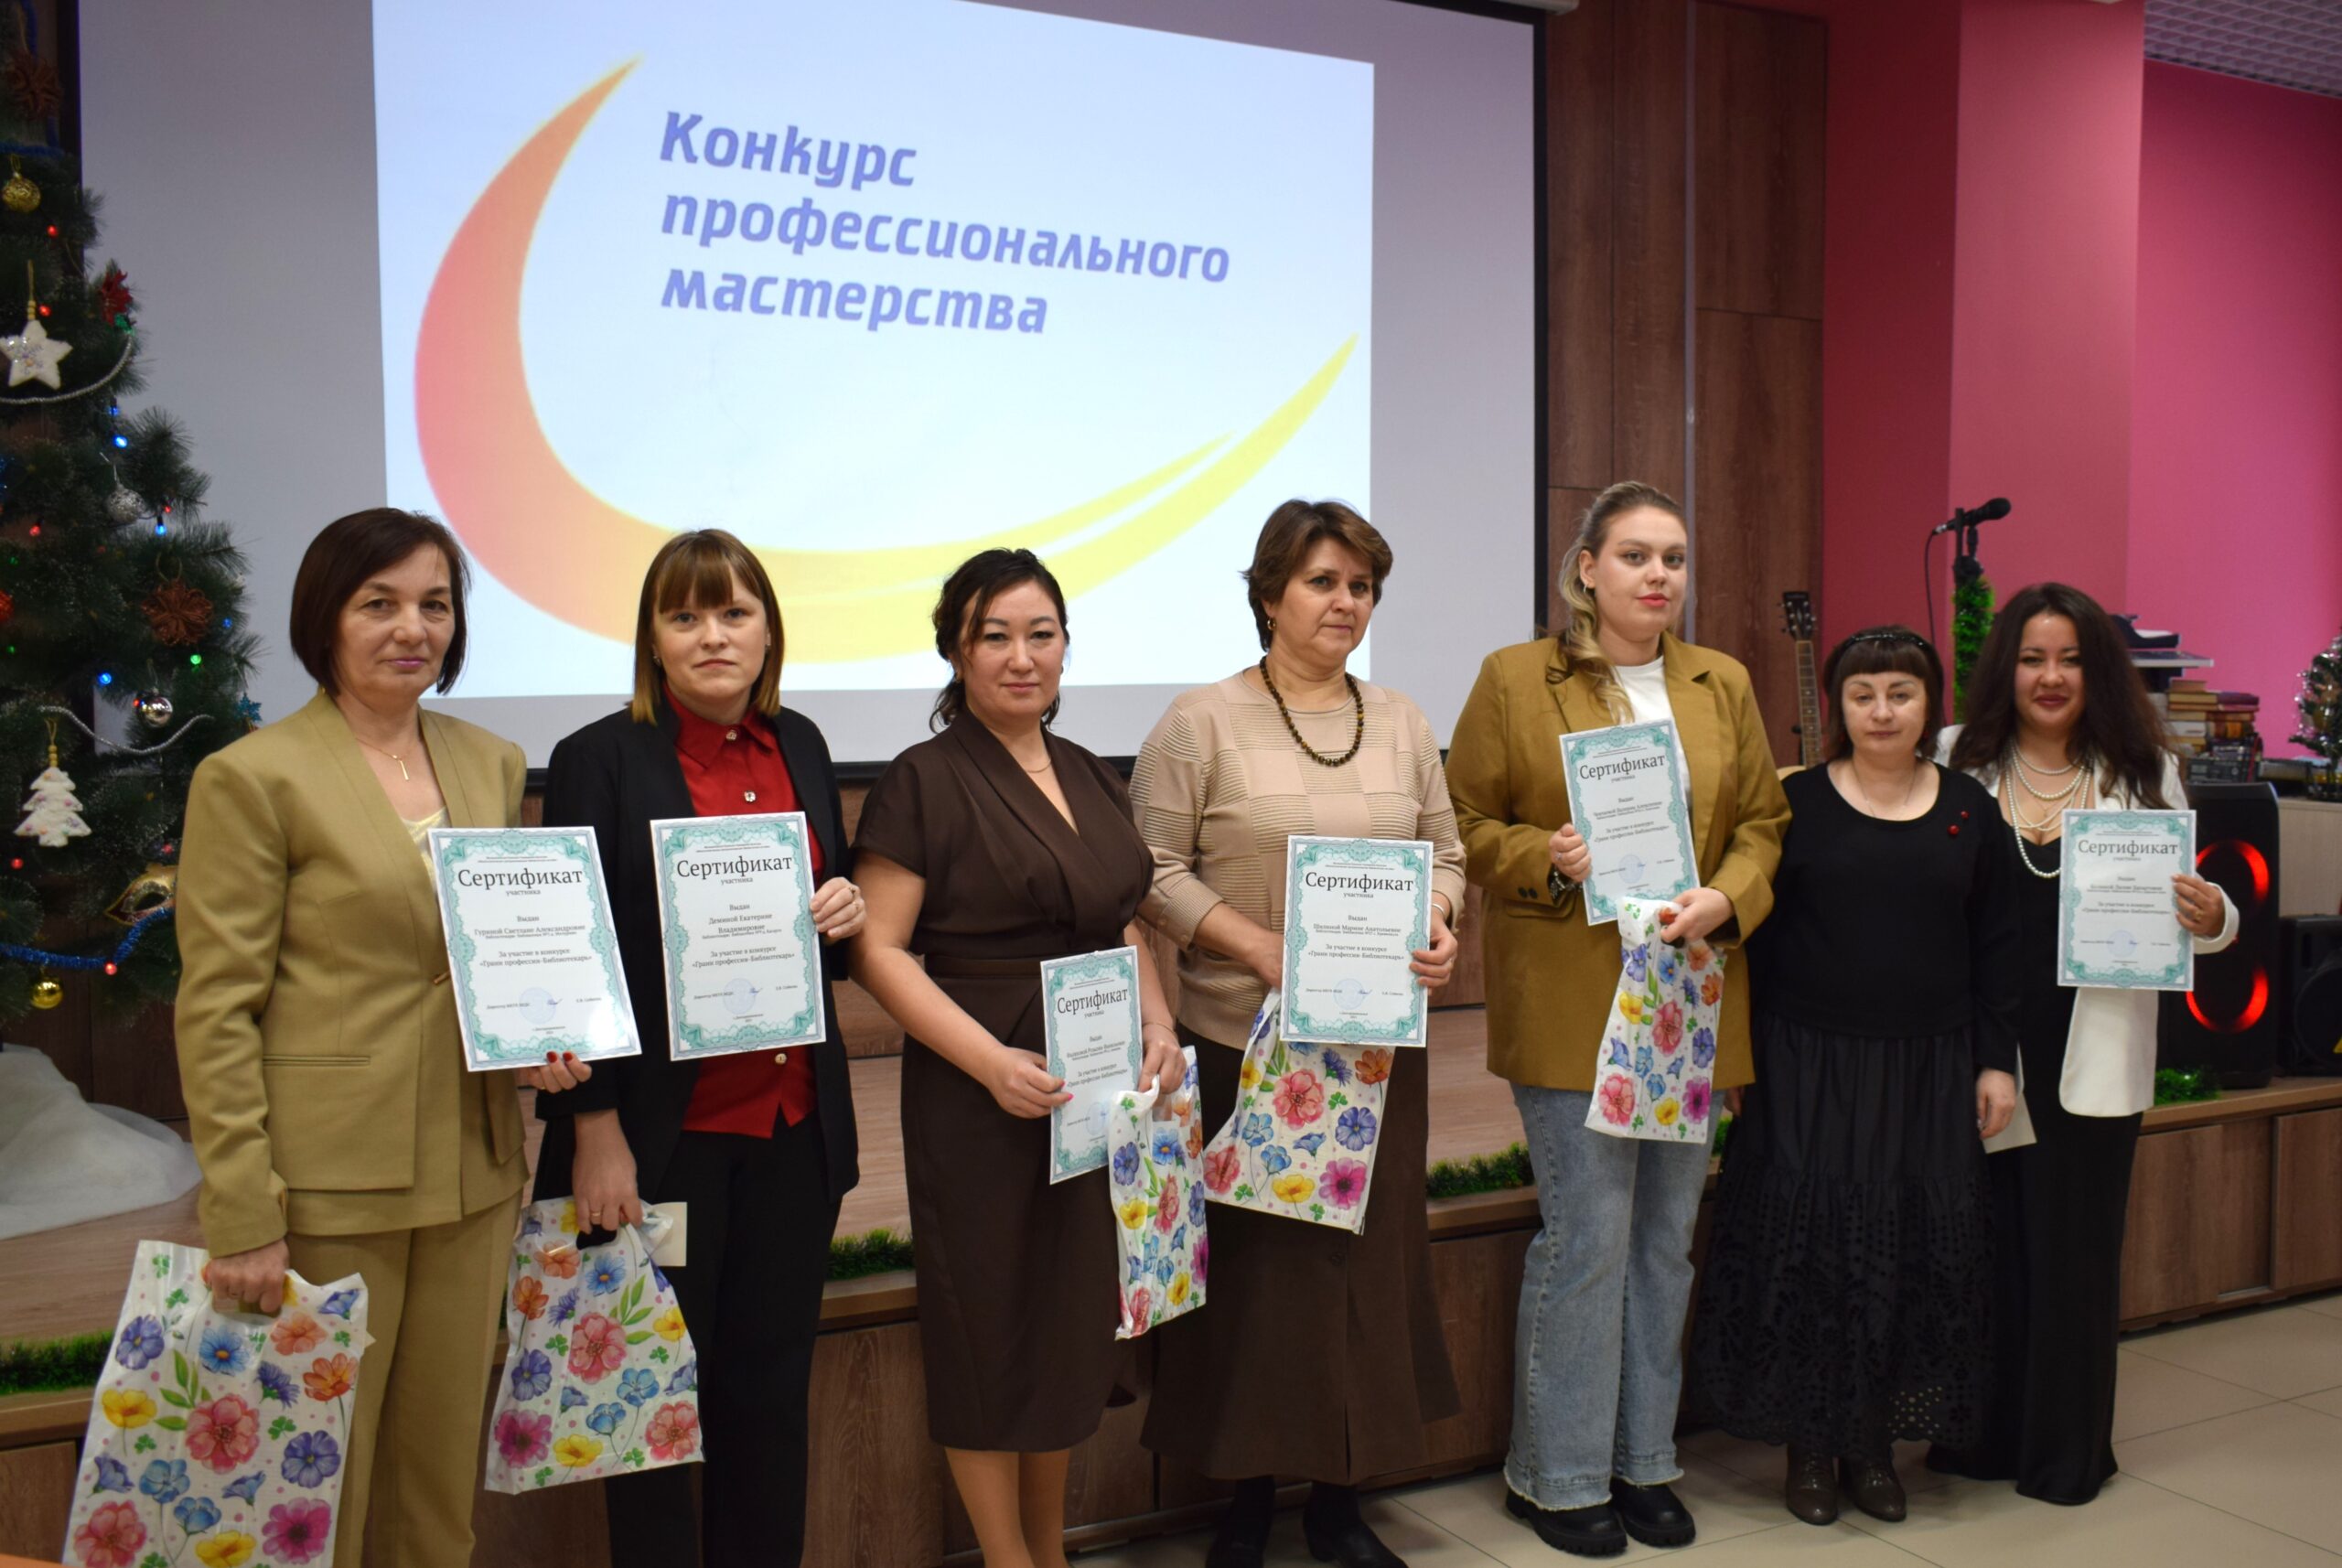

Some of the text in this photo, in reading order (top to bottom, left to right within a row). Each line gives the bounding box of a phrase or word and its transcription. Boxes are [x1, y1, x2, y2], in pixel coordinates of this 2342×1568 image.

[659, 111, 917, 191] Конкурс
[661, 193, 1230, 284] профессионального
[661, 267, 1047, 332] мастерства
[1580, 756, 1665, 779] Сертификат
[2078, 839, 2178, 856] Сертификат
[677, 855, 792, 880] Сертификат
[458, 868, 583, 890] Сертификат
[720, 877, 754, 886] участника
[1305, 872, 1413, 893] Сертификат
[506, 888, 542, 897] участника
[719, 949, 743, 958] участие
[748, 946, 777, 954] конкурсе
[1058, 989, 1128, 1015] Сертификат
